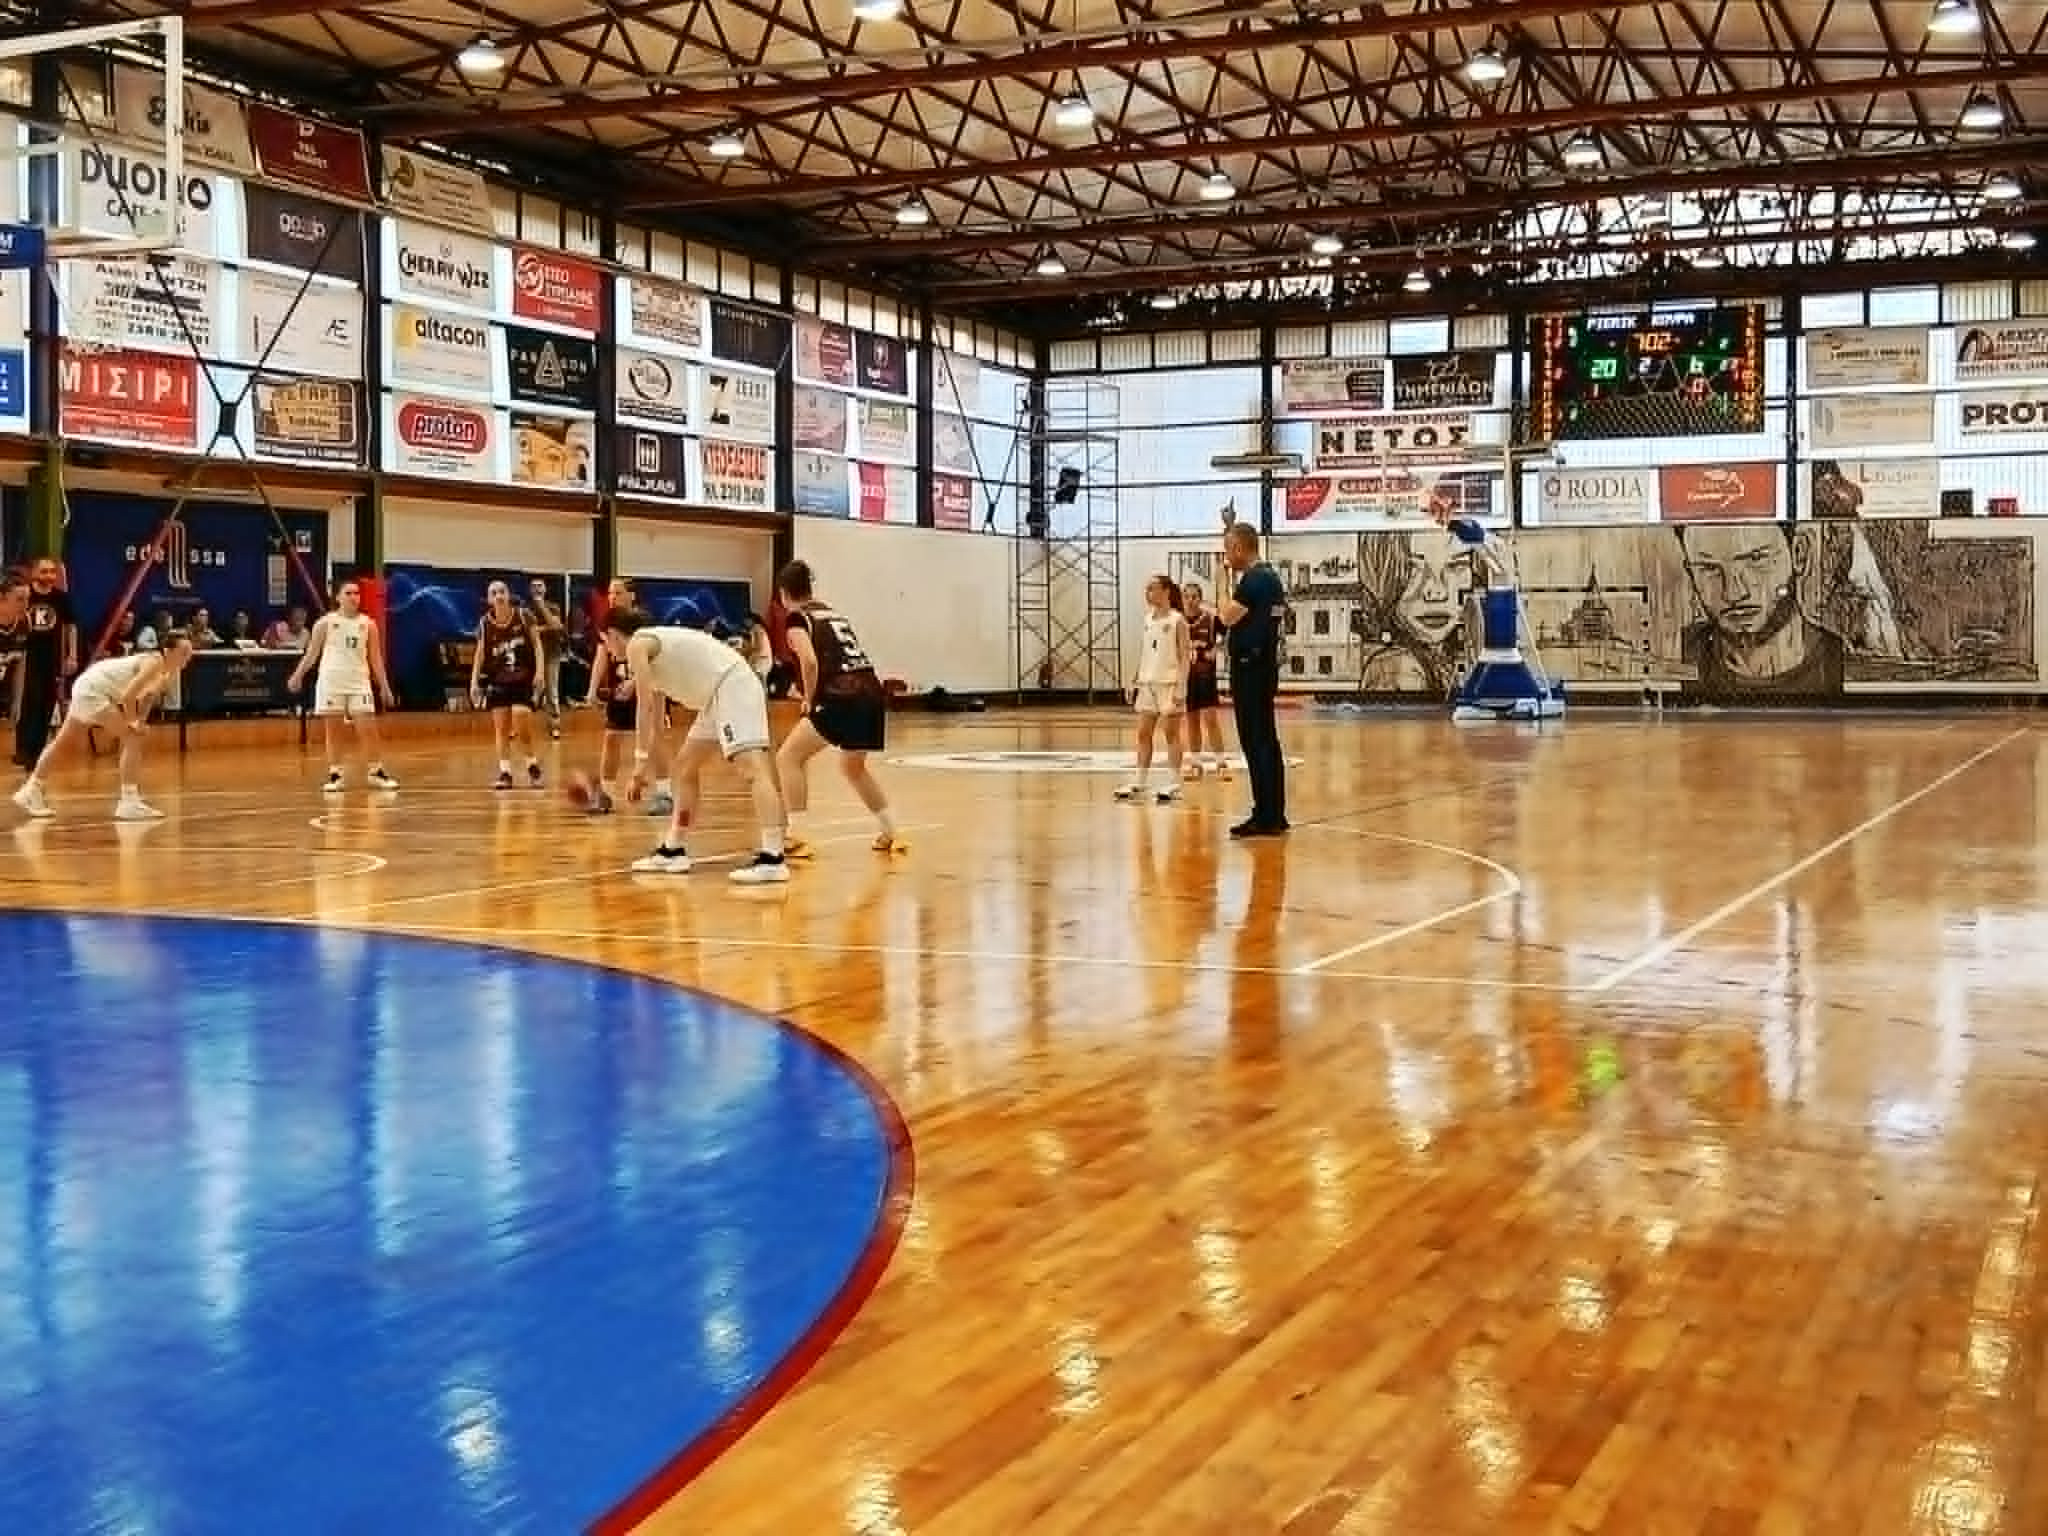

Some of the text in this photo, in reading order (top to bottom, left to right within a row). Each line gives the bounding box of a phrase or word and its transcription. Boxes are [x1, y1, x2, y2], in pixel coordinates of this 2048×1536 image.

[399, 247, 490, 289] CHERRY WIZ
[415, 317, 487, 350] altacon
[58, 360, 189, 407] ΜΙΣΙΡΙ
[1590, 359, 1617, 379] 20
[414, 412, 477, 442] proton
[1321, 425, 1469, 454] ΝΕΤΟΣ
[1568, 475, 1643, 498] RODIA
